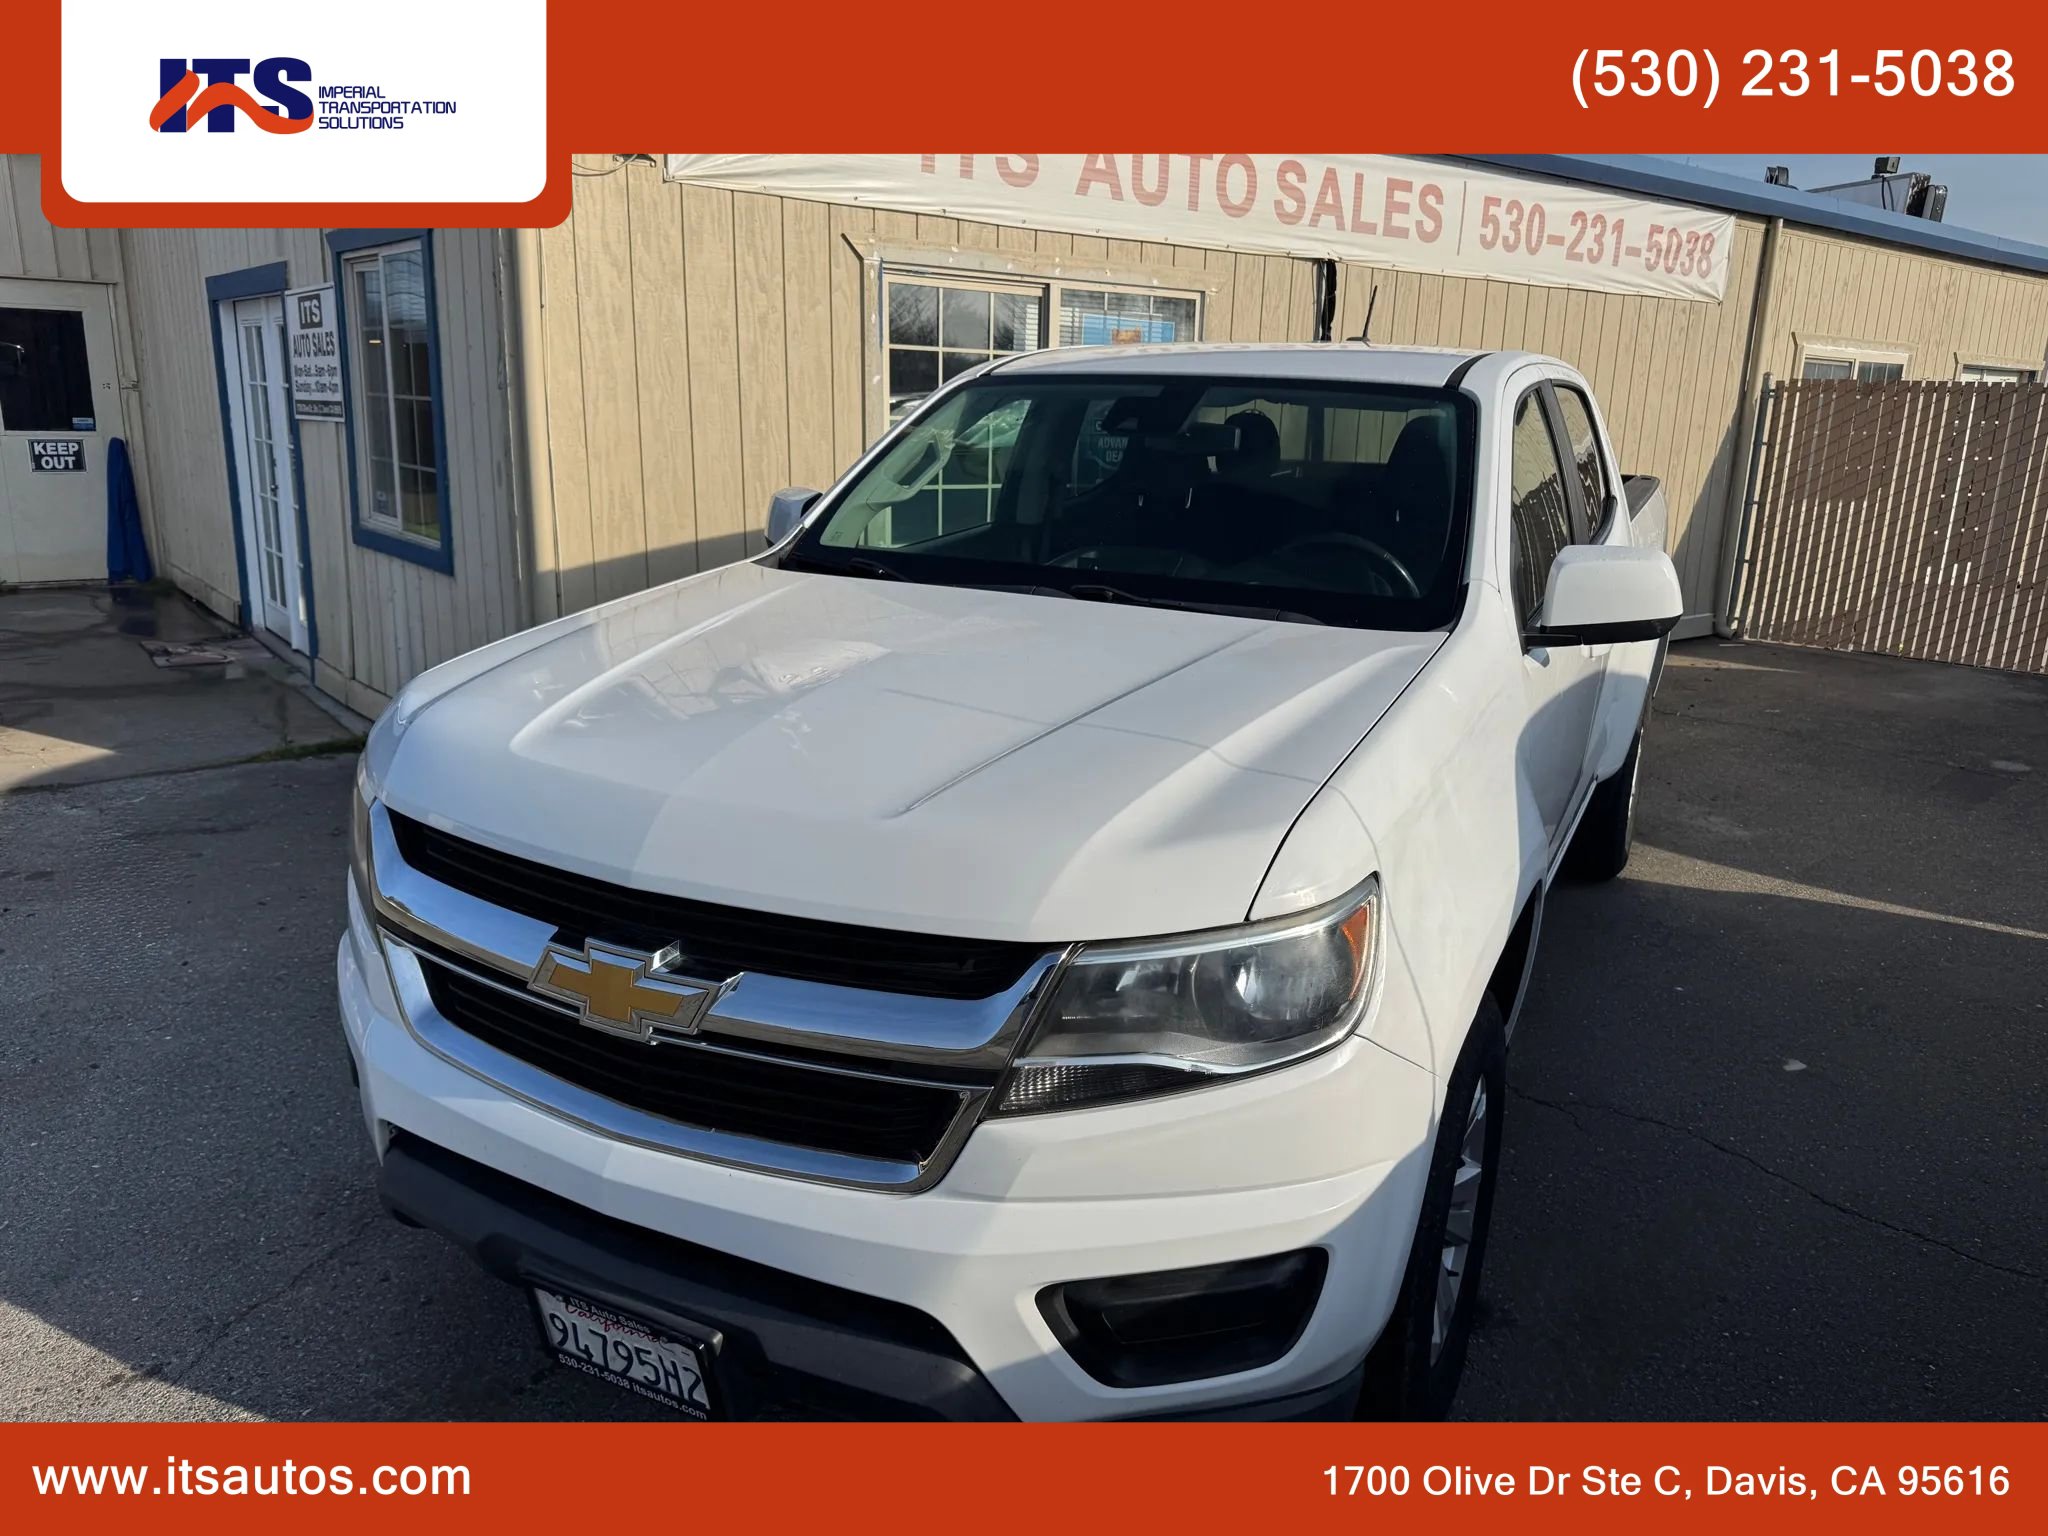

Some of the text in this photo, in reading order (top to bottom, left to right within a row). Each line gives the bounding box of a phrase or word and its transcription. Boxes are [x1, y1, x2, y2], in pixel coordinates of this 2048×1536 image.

[1075, 154, 1257, 218] AUTO
[1274, 160, 1444, 243] SALES
[1479, 195, 1715, 279] 530-231-5038
[300, 299, 320, 325] ITS
[293, 330, 335, 358] AUTO SALES
[33, 442, 79, 455] KEEP
[41, 456, 76, 469] OUT
[569, 1296, 650, 1333] ITS Auto Sales
[558, 1353, 708, 1421] 530-231-5038 itsautos.com
